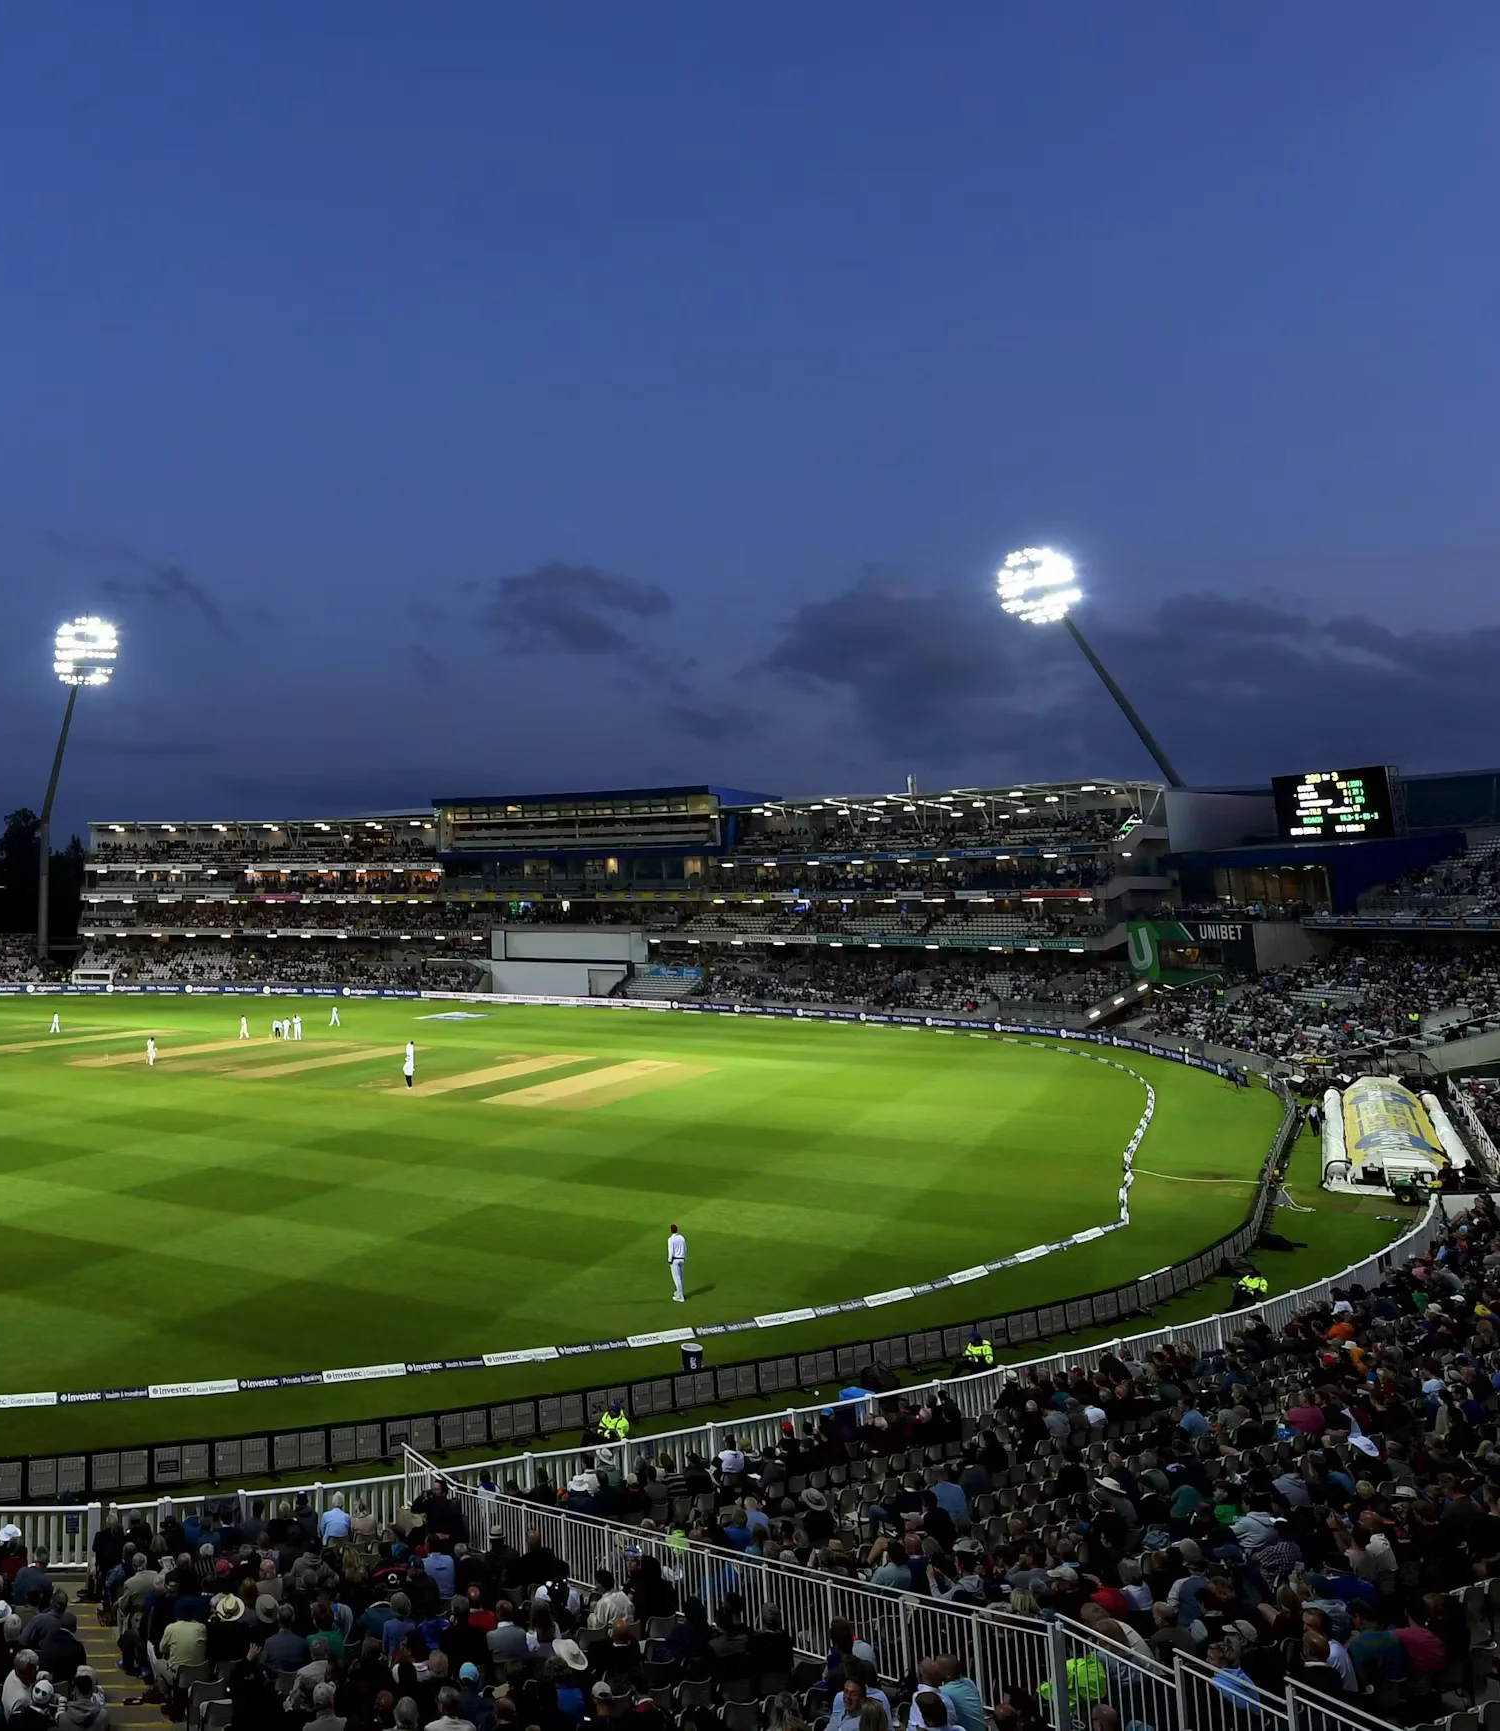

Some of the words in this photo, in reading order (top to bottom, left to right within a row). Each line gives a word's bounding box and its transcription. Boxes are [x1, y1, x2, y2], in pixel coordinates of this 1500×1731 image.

[1200, 924, 1242, 940] UNIBET
[565, 1346, 591, 1354] Investec
[492, 1354, 520, 1363] Investec
[412, 1362, 443, 1372] Investec
[332, 1370, 362, 1380] Investec
[247, 1378, 278, 1388] Investec
[282, 1376, 300, 1384] Private
[160, 1386, 192, 1395] Investec
[67, 1391, 101, 1402] Investec
